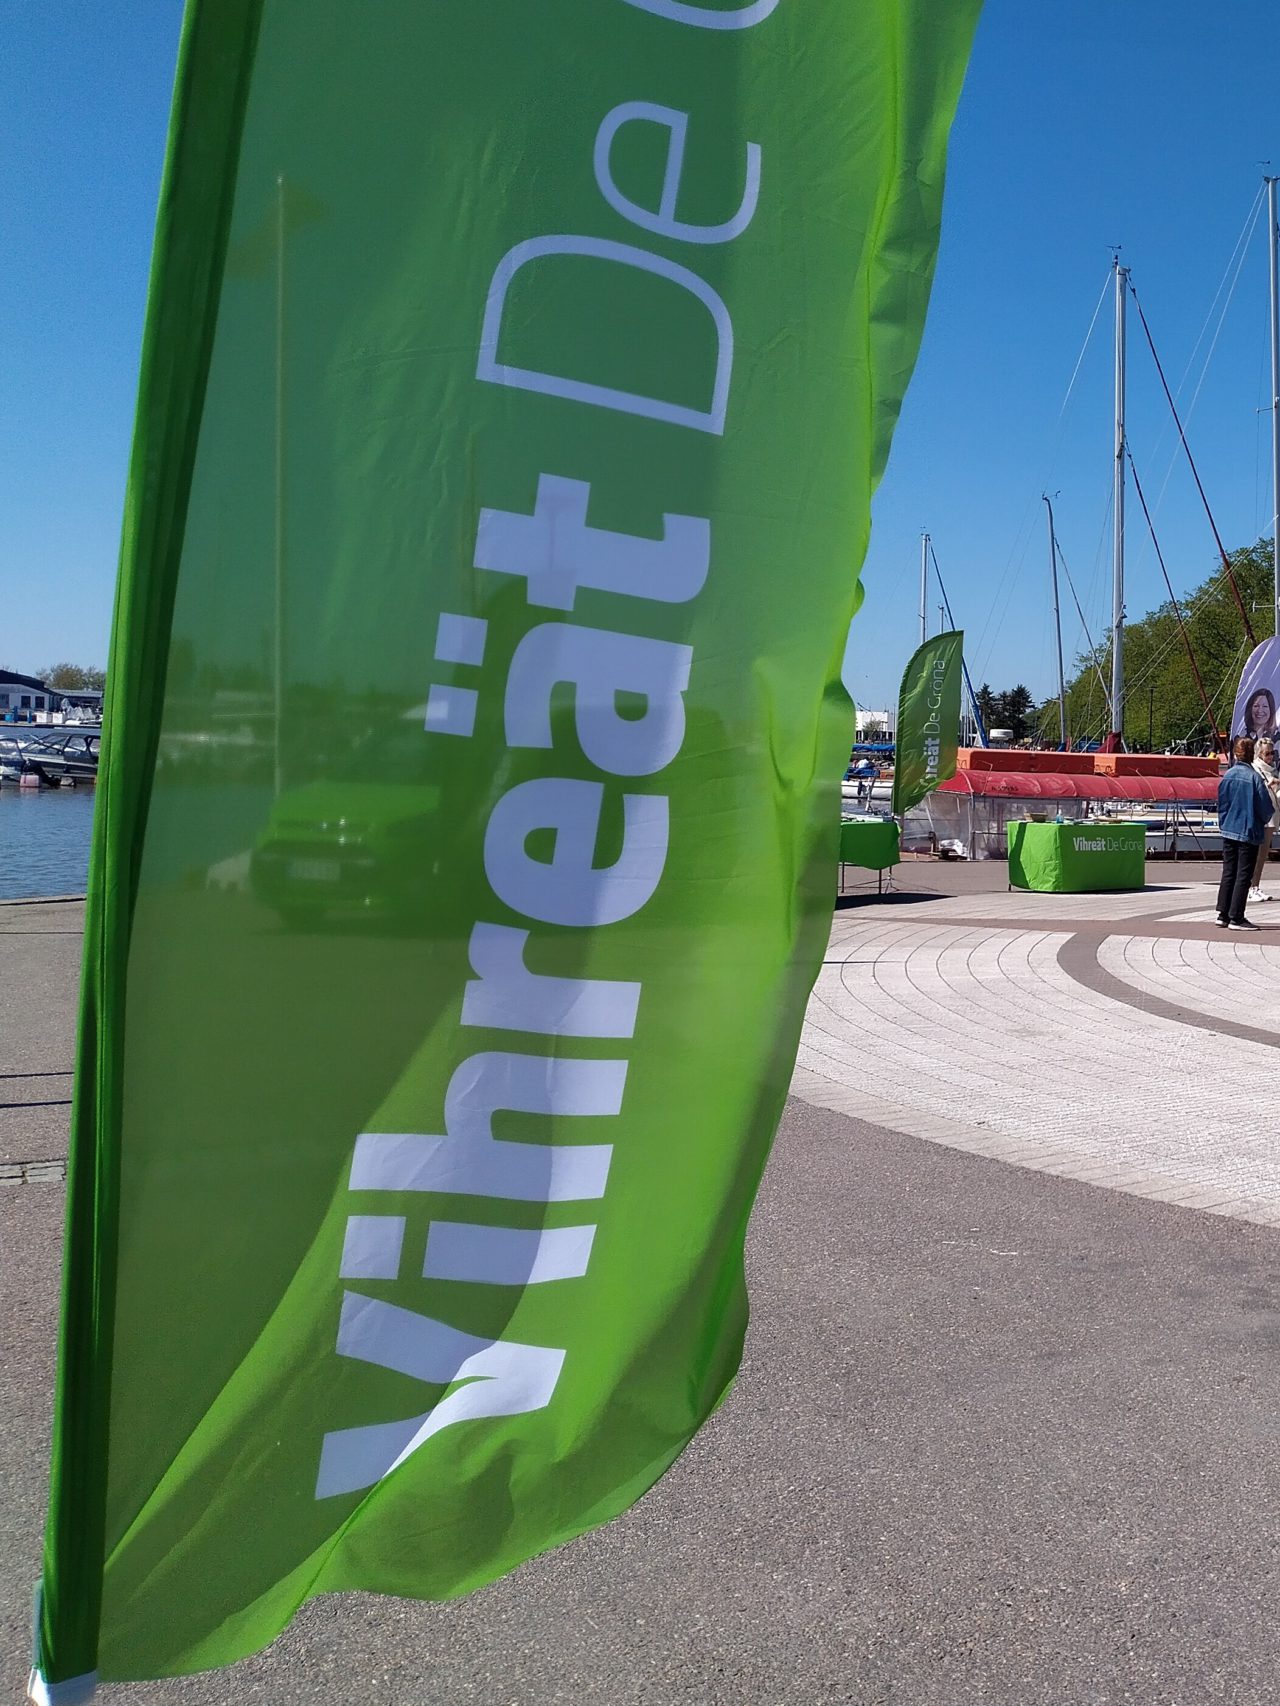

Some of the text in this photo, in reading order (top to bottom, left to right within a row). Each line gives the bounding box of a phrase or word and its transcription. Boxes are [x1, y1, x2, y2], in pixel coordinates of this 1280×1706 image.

[476, 101, 761, 435] De
[928, 660, 945, 709] Gröna
[924, 713, 940, 734] De
[1073, 837, 1143, 851] Vihreät De Gröna
[315, 473, 711, 1499] Vihreät
